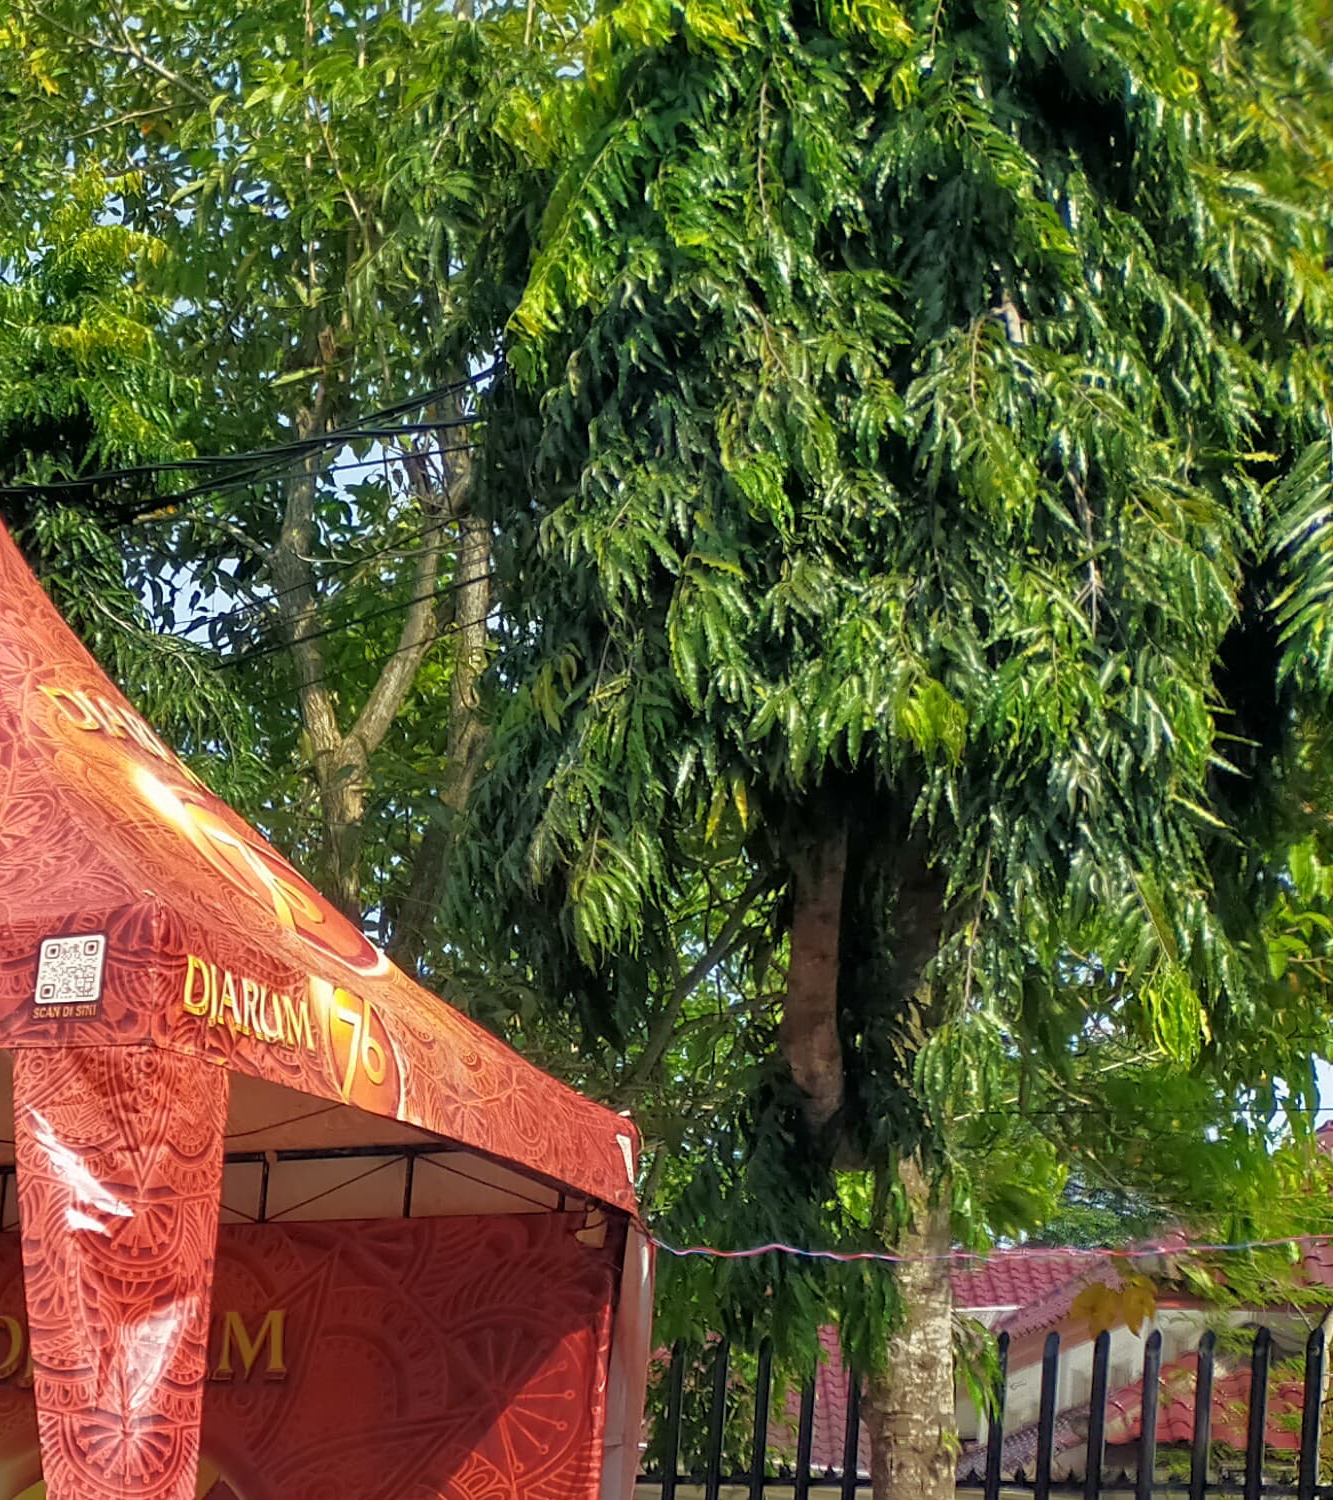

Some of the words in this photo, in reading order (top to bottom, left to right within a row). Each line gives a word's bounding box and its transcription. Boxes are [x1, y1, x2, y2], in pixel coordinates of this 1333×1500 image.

[32, 1007, 61, 1019] SCAN
[62, 1006, 74, 1017] DI
[75, 1005, 98, 1017] SINI
[184, 954, 316, 1050] DJARUM
